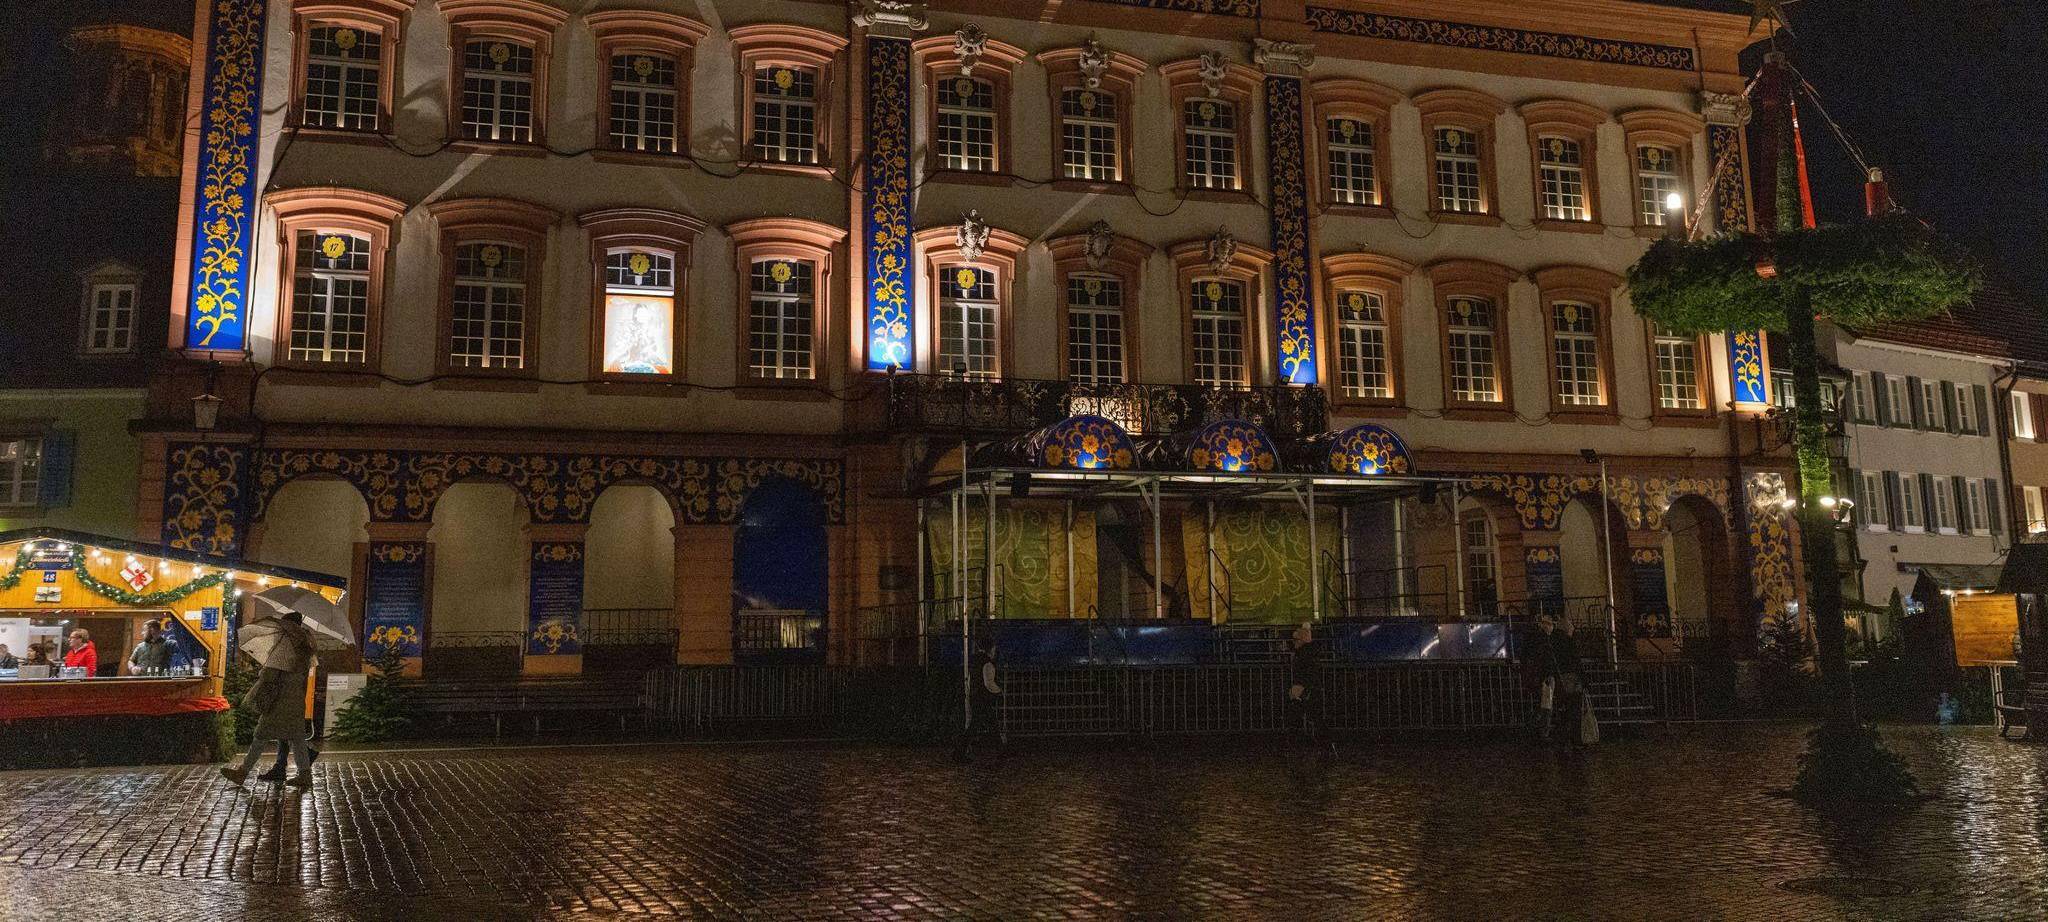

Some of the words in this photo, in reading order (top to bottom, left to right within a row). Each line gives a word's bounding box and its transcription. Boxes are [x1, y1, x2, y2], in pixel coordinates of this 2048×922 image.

[330, 243, 339, 252] 17
[637, 261, 642, 269] 1
[777, 268, 785, 277] 14
